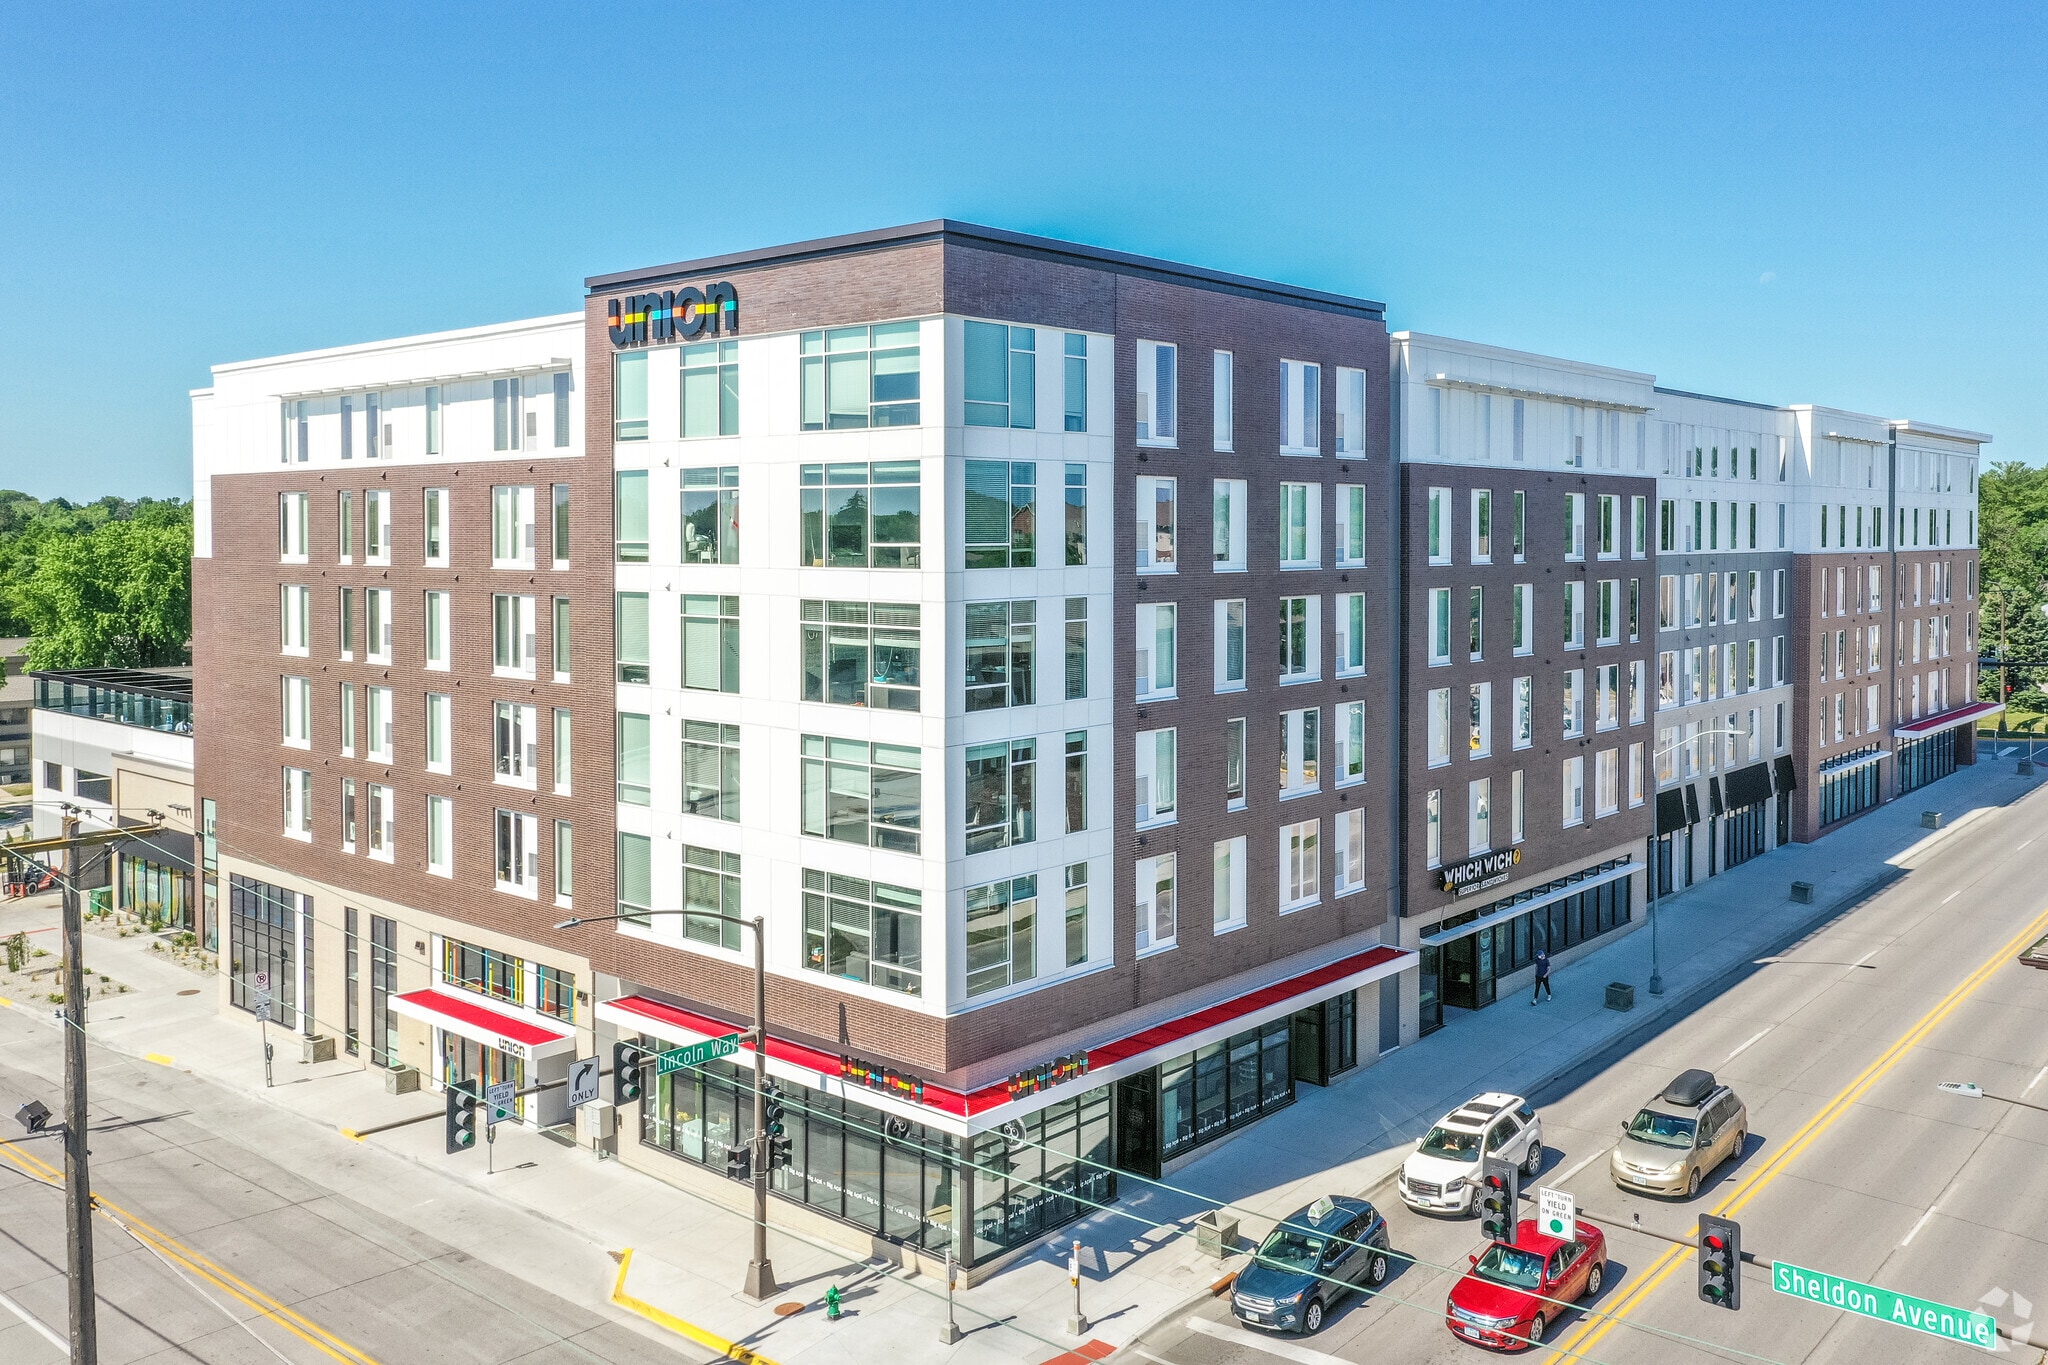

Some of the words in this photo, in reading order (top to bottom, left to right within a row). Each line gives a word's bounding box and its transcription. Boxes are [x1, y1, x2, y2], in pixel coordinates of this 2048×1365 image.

[608, 281, 738, 346] union
[1445, 861, 1482, 884] WHICH
[1459, 883, 1480, 896] SUPERIOR
[1481, 873, 1509, 889] SANDWICHES
[658, 1046, 704, 1073] Lincoln
[711, 1038, 737, 1057] Way
[494, 1091, 509, 1100] YIELD
[498, 1098, 512, 1106] GREEN
[572, 1088, 594, 1103] ONLY
[1541, 1189, 1553, 1198] LEFT
[1555, 1192, 1571, 1202] TURN
[1547, 1199, 1566, 1211] YIELD
[1552, 1210, 1571, 1220] GREEN
[1779, 1267, 1878, 1315] Sheldon
[1892, 1297, 1990, 1345] Avenue
